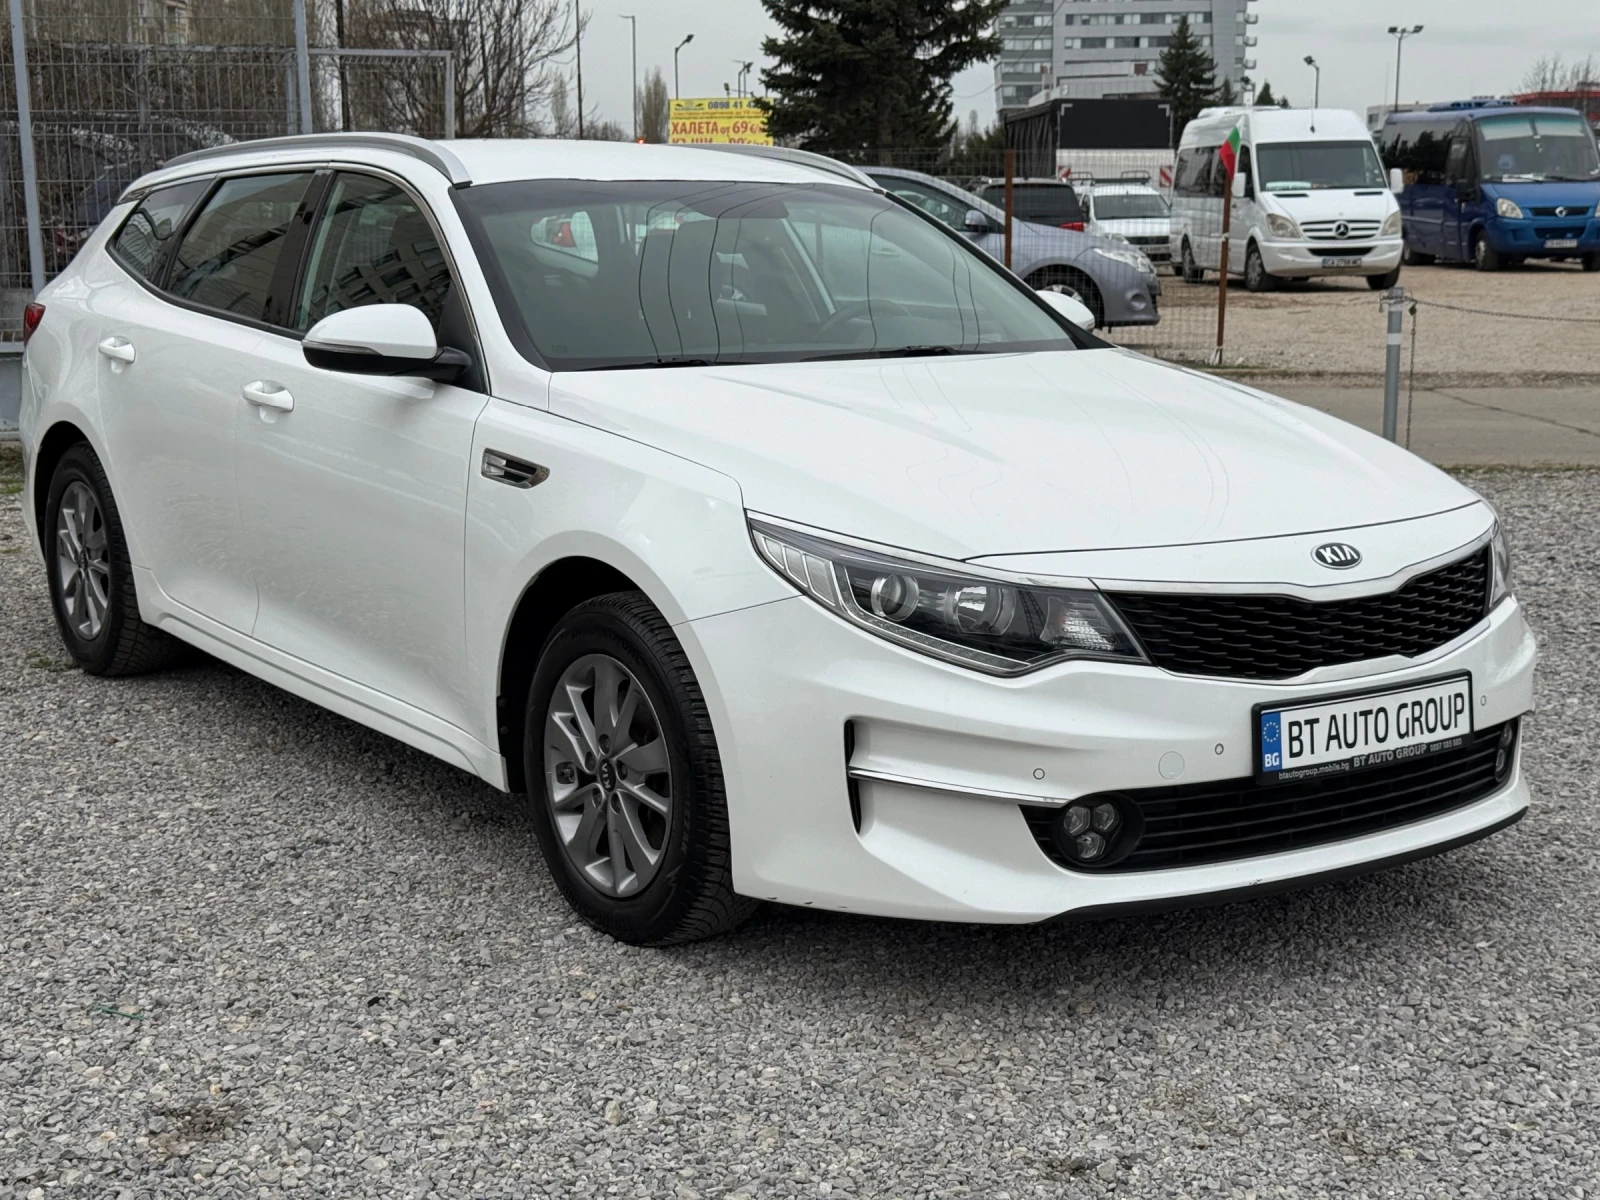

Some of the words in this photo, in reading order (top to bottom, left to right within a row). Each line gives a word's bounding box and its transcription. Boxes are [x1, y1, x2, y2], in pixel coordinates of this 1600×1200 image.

[672, 121, 719, 134] ХАЛЕТА
[1318, 545, 1358, 563] KIA
[1288, 717, 1320, 759] BT
[1325, 706, 1389, 752] AUTO
[1396, 692, 1465, 740] GROUP
[1264, 752, 1280, 768] BG
[1278, 761, 1350, 780] btautogroup.mobile.bg
[1353, 756, 1367, 768] BT
[1368, 750, 1394, 765] AUTO
[1395, 744, 1427, 759] GROUP
[601, 762, 611, 789] KIA
